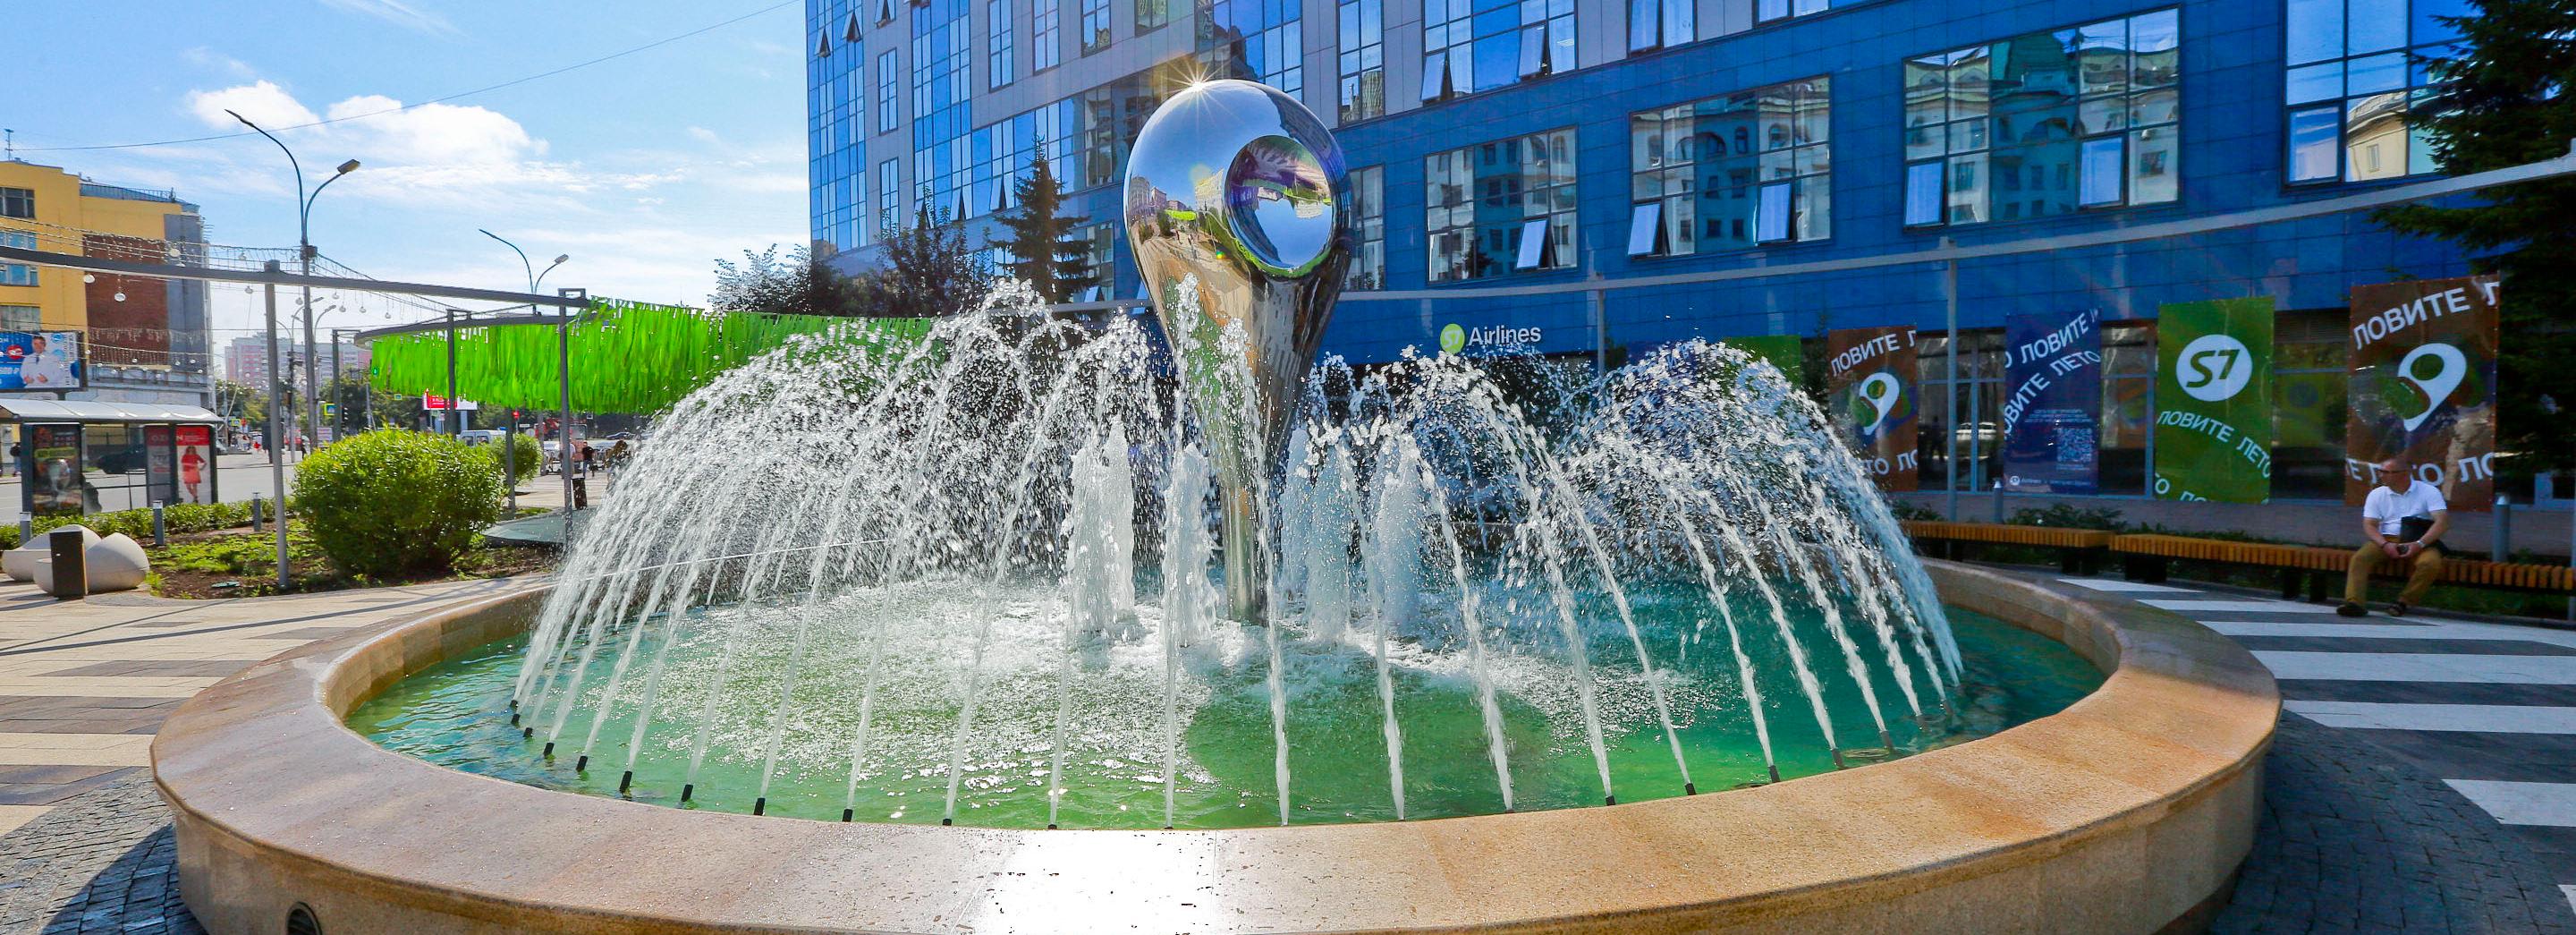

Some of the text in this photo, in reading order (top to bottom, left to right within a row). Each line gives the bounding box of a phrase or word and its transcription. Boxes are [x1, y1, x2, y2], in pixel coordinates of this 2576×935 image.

[1469, 325, 1542, 346] Airlines
[2020, 312, 2089, 364] ЛОВИТЕ
[2352, 287, 2471, 351] ЛОВИТЕ
[1831, 333, 1901, 377] ЛОВИТЕ
[2049, 350, 2101, 377] ЛЕТО
[2186, 349, 2241, 388] S7
[2157, 411, 2235, 443] ЛОВИТЕ
